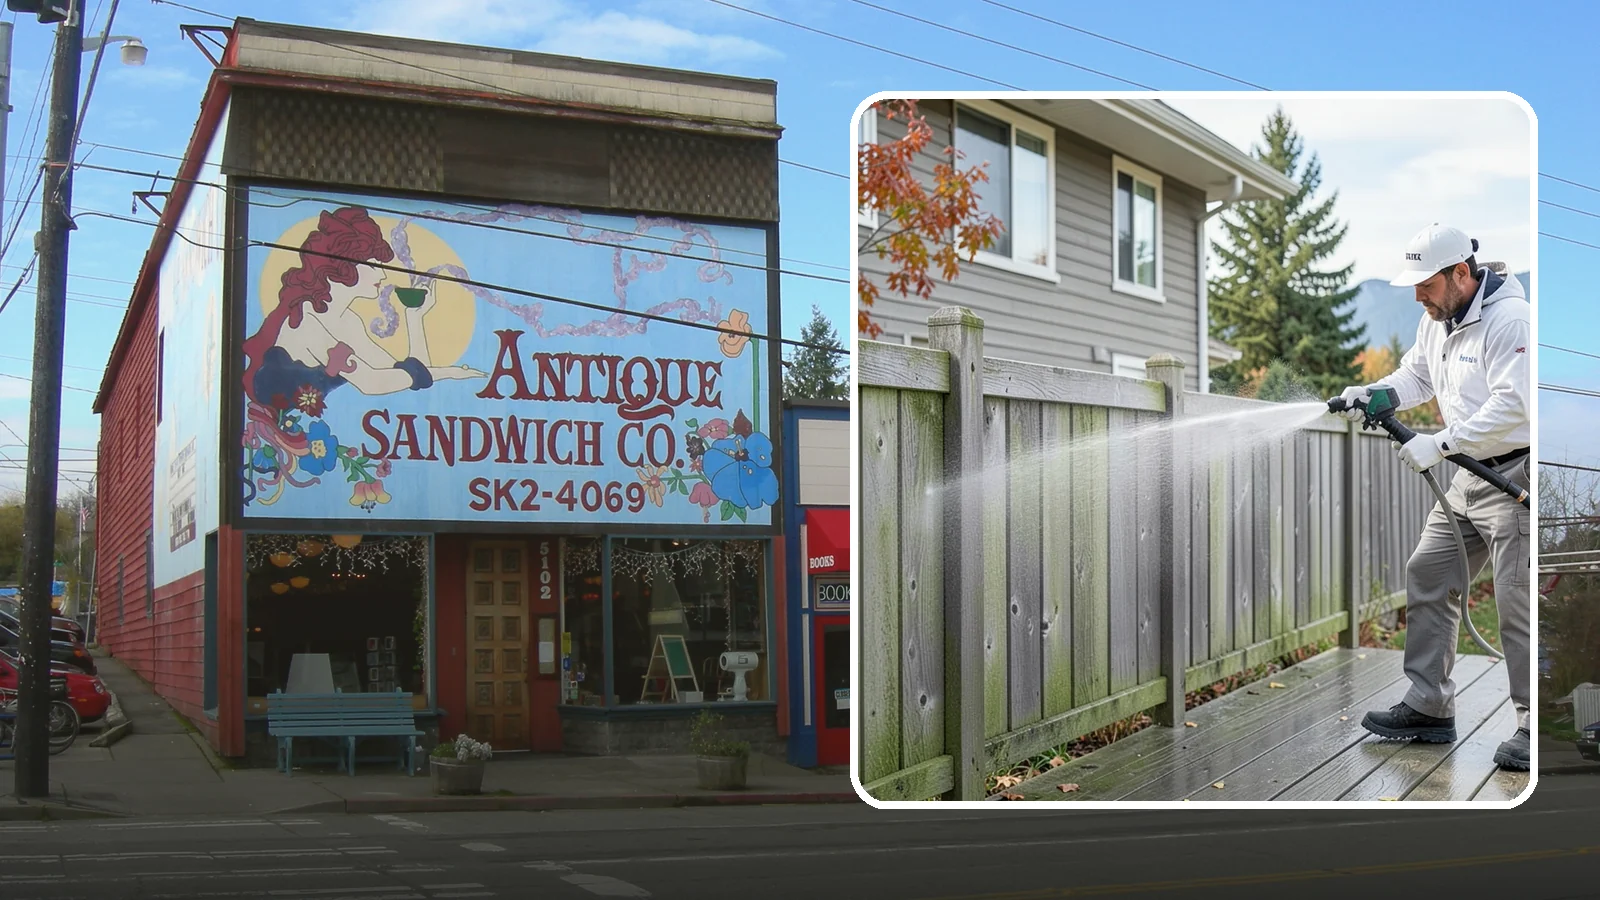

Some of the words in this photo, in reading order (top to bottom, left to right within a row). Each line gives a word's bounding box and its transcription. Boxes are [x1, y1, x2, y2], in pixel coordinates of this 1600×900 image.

[475, 329, 724, 421] ANTIQUE
[361, 408, 604, 468] SANDWICH
[617, 421, 685, 469] CO.
[468, 477, 646, 513] SK2-4069
[540, 542, 551, 599] 5102
[809, 555, 835, 569] BOOKS
